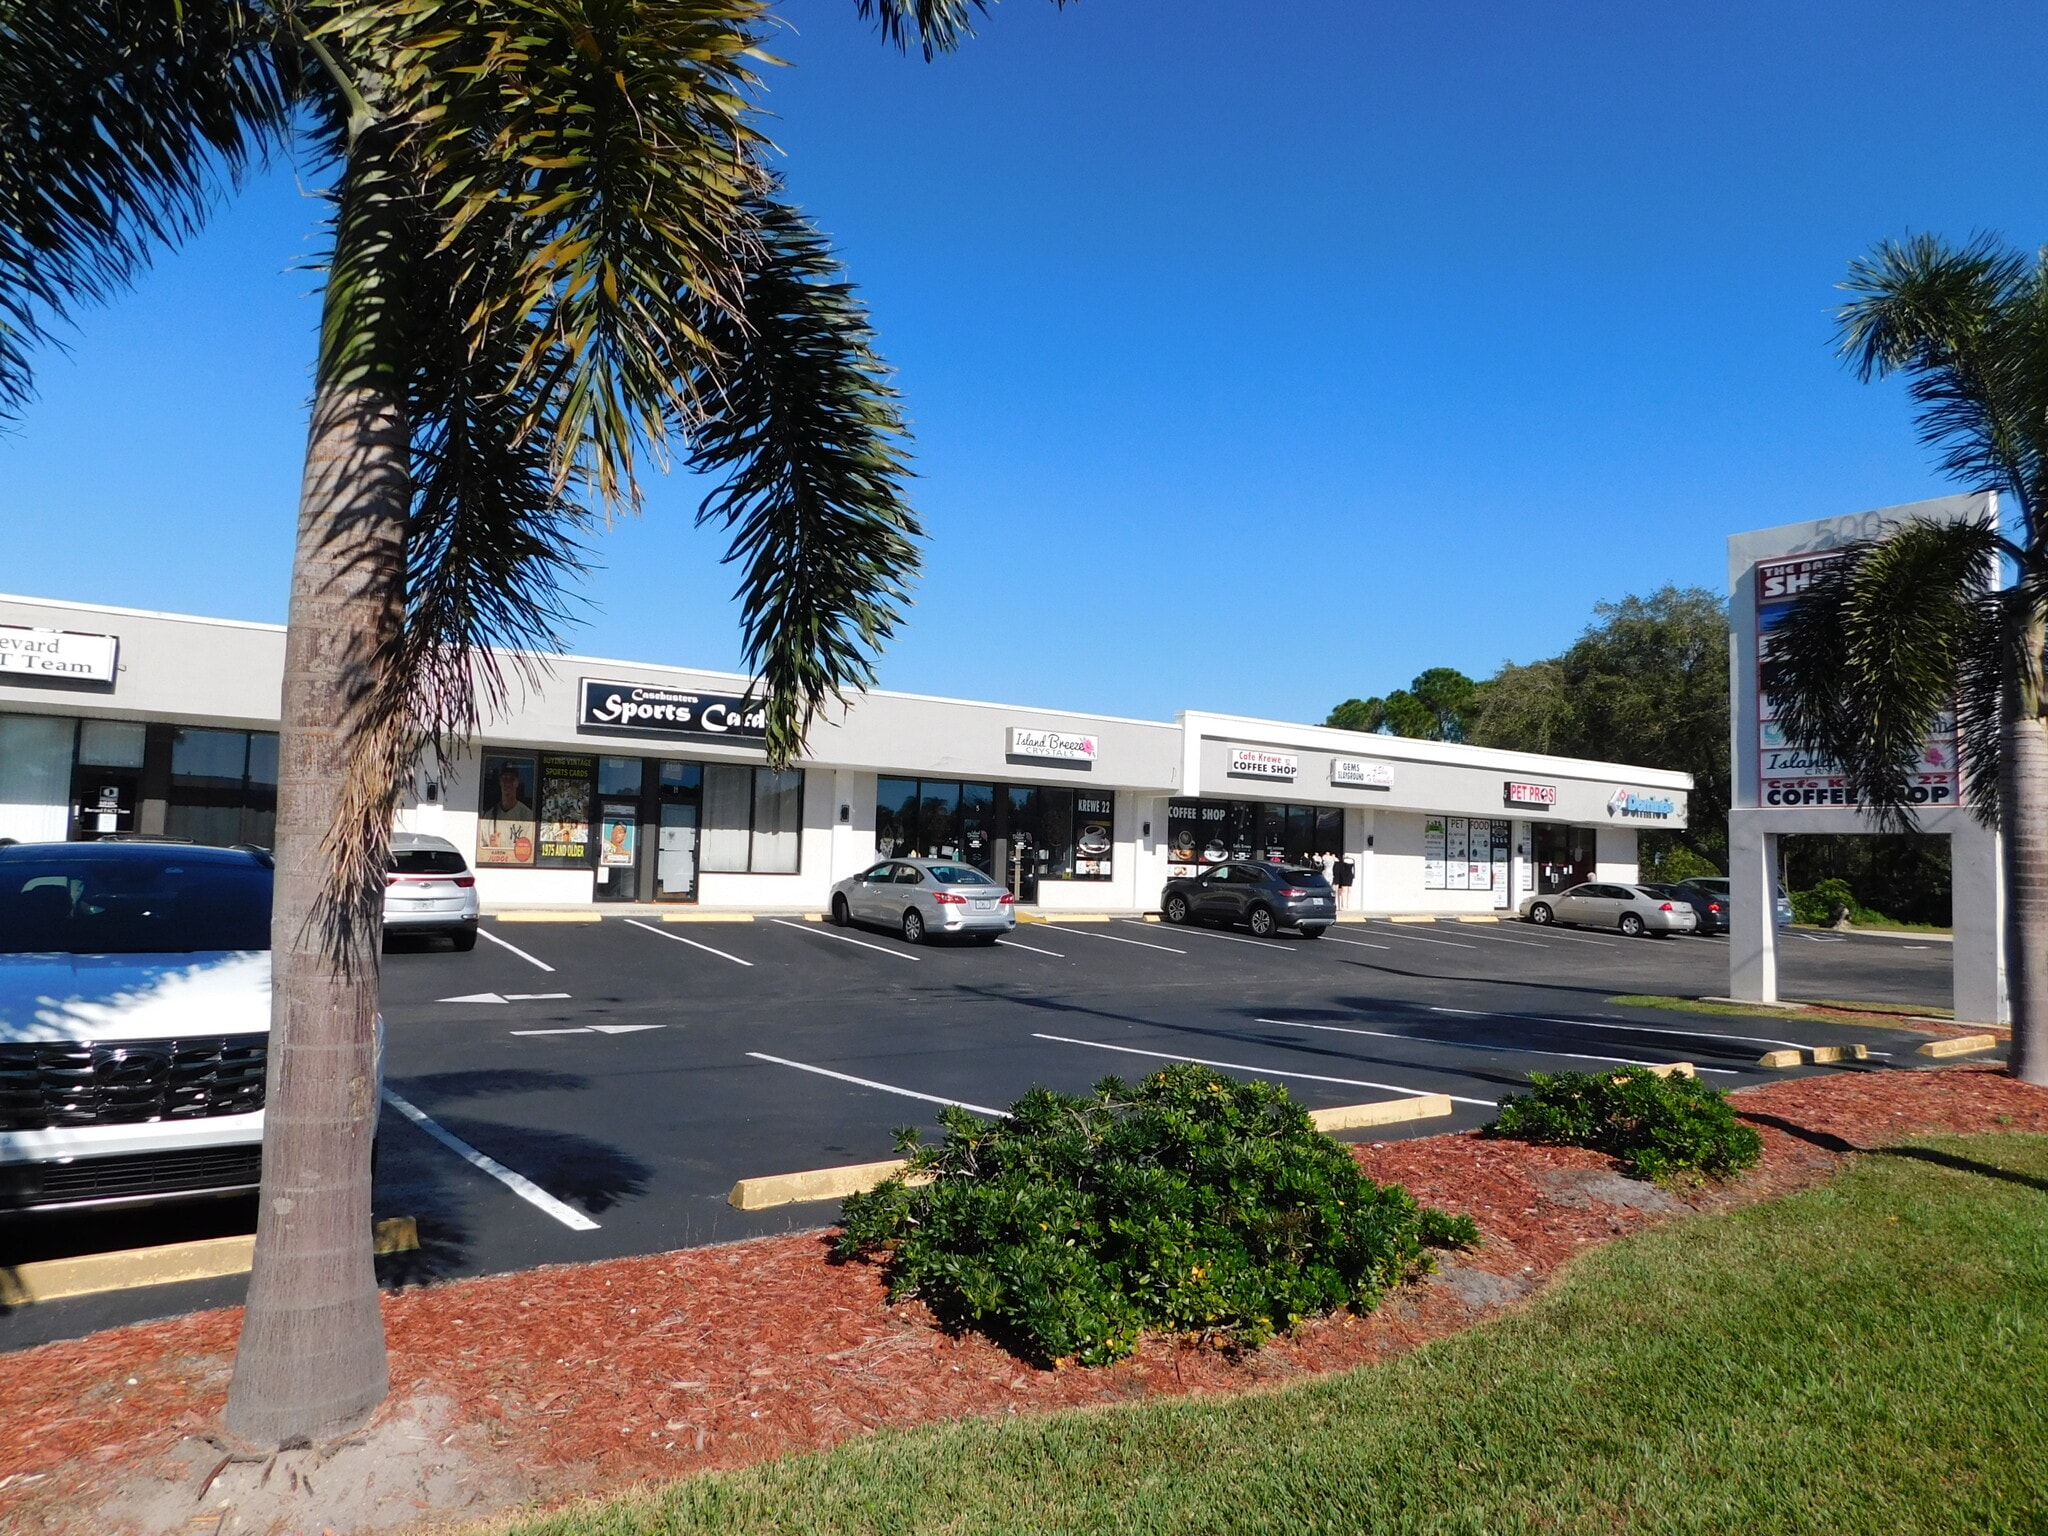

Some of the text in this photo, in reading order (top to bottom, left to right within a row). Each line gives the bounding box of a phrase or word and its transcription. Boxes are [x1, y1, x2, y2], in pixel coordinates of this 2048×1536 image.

[1815, 510, 1881, 548] 500
[1764, 564, 1795, 577] THE
[21, 654, 94, 674] Team
[631, 688, 699, 704] Casebusters
[593, 694, 769, 732] Sports Card
[1016, 733, 1085, 751] Island Breeze
[1025, 746, 1075, 757] CRYSTALS
[1239, 751, 1256, 762] Cafe
[1258, 753, 1282, 764] Krewe
[1343, 763, 1360, 772] GEMS
[1766, 750, 1837, 771] Island
[545, 767, 589, 778] SPORTS CARDS
[1233, 761, 1297, 775] COFFEE SHOP
[1337, 771, 1364, 781] SLAYGROUND
[1918, 775, 1949, 785] 22
[1511, 784, 1555, 803] PET PROS
[1767, 788, 1859, 805] COFFEE
[1078, 799, 1111, 814] KREWE 22
[1168, 806, 1226, 821] COFFEE SHOP
[1451, 819, 1490, 831] PET FOOD
[541, 843, 555, 856] 1975
[555, 844, 567, 856] AND
[567, 844, 585, 857] OLDER
